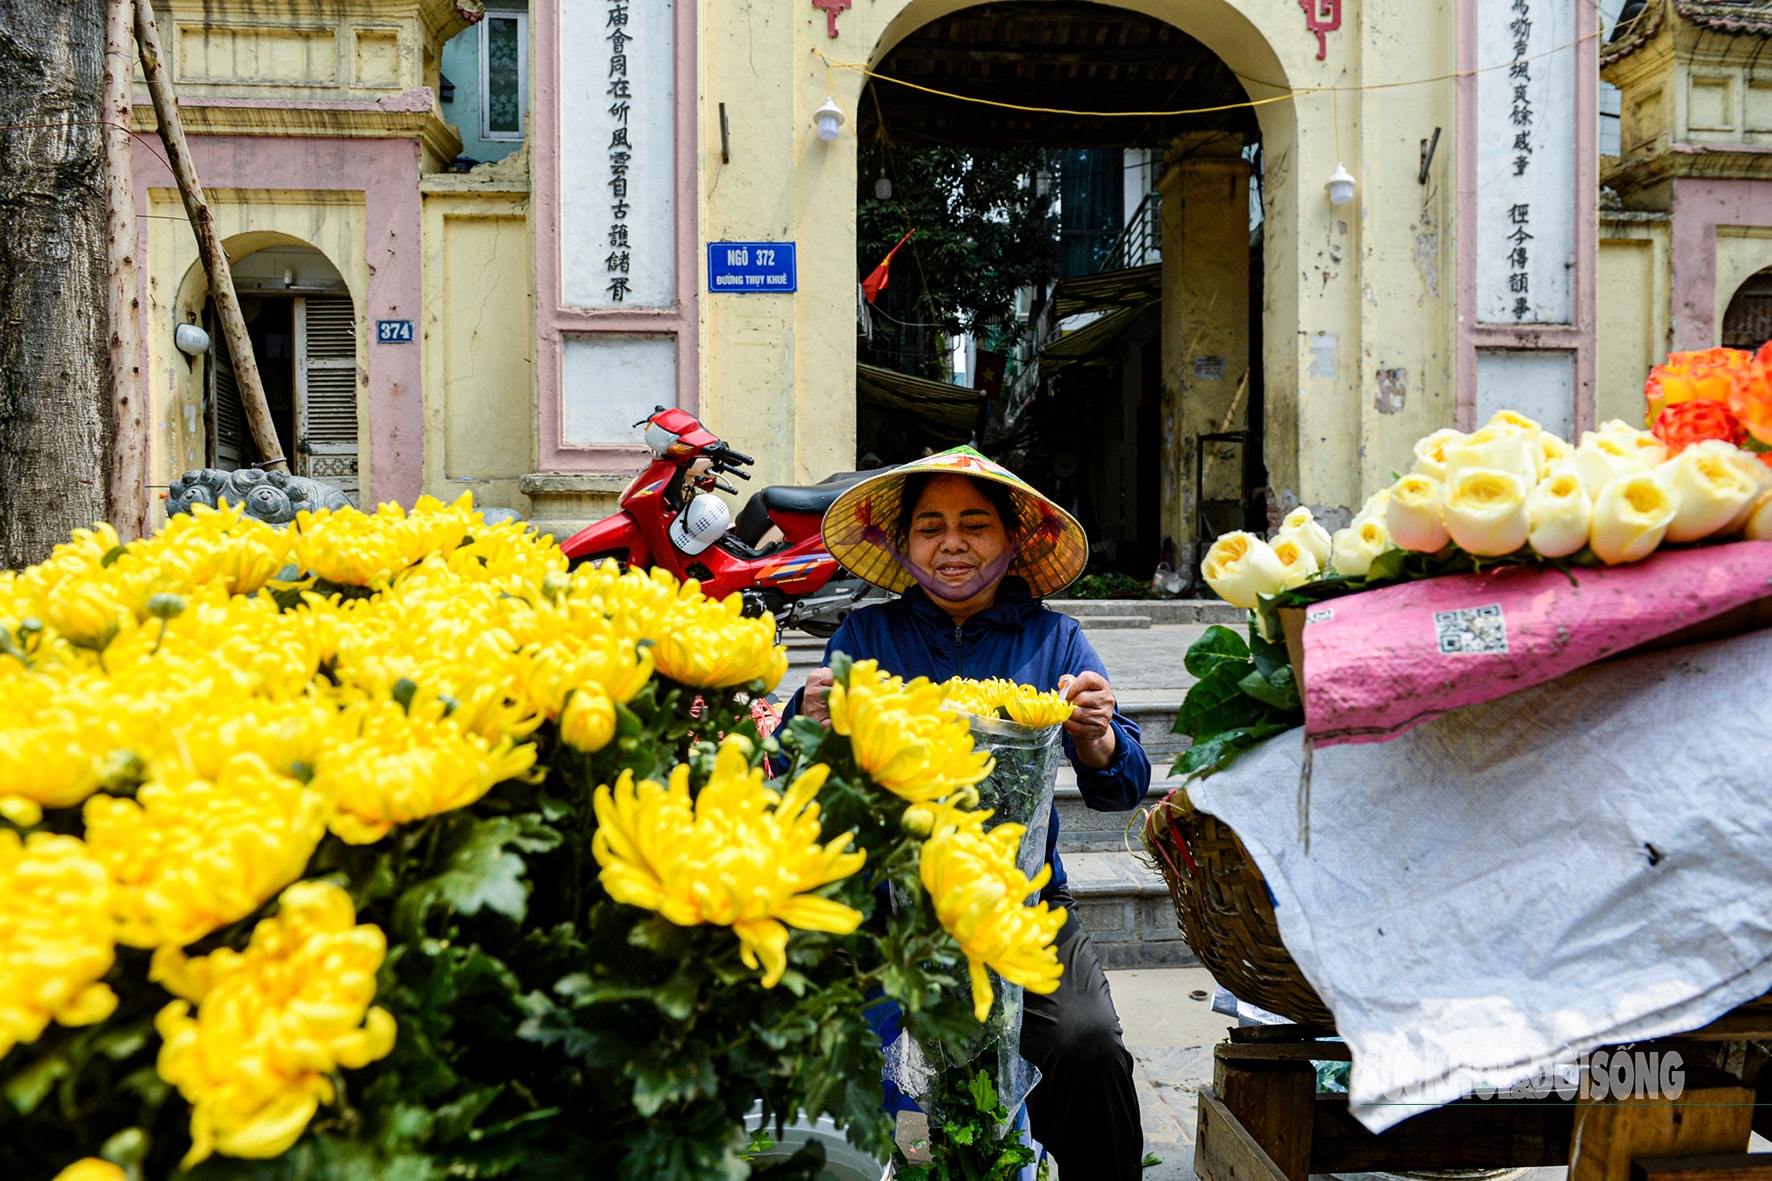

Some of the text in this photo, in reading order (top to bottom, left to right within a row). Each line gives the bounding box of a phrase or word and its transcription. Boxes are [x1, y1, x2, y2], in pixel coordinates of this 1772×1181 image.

[727, 246, 775, 266] NGÕ 372
[716, 272, 788, 287] ĐƯỜNG THỤY KHUÊ
[381, 322, 410, 339] 374
